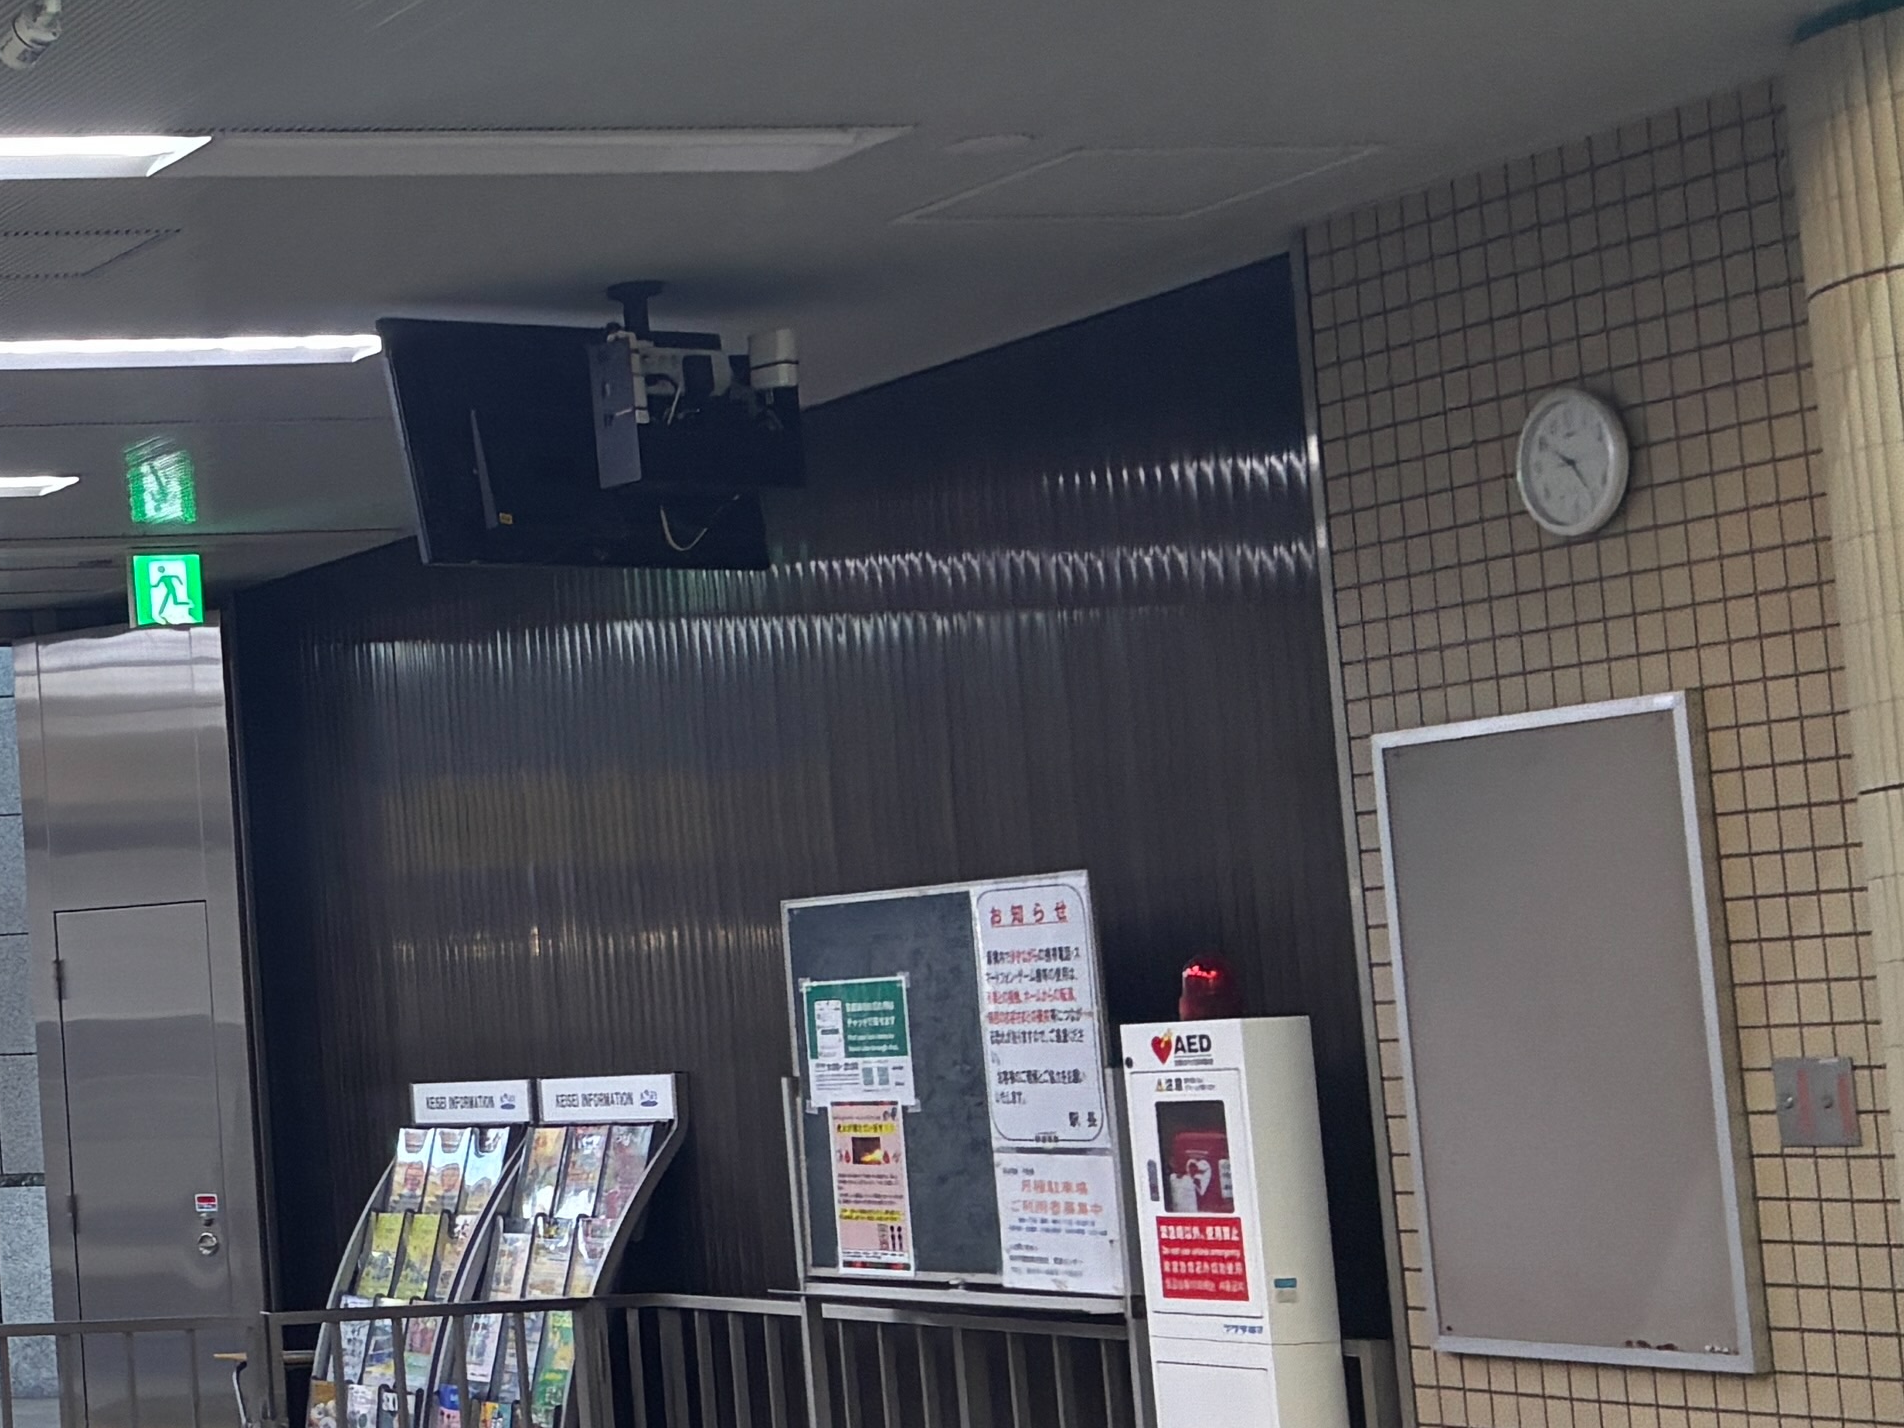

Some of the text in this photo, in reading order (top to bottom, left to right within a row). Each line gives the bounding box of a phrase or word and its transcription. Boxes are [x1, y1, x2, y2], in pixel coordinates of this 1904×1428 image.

[990, 899, 1069, 926] お知らせ
[1173, 1033, 1213, 1055] AED
[425, 1094, 496, 1110] KEISEI INFORMATION
[555, 1091, 634, 1108] KEISEI INFORMATION
